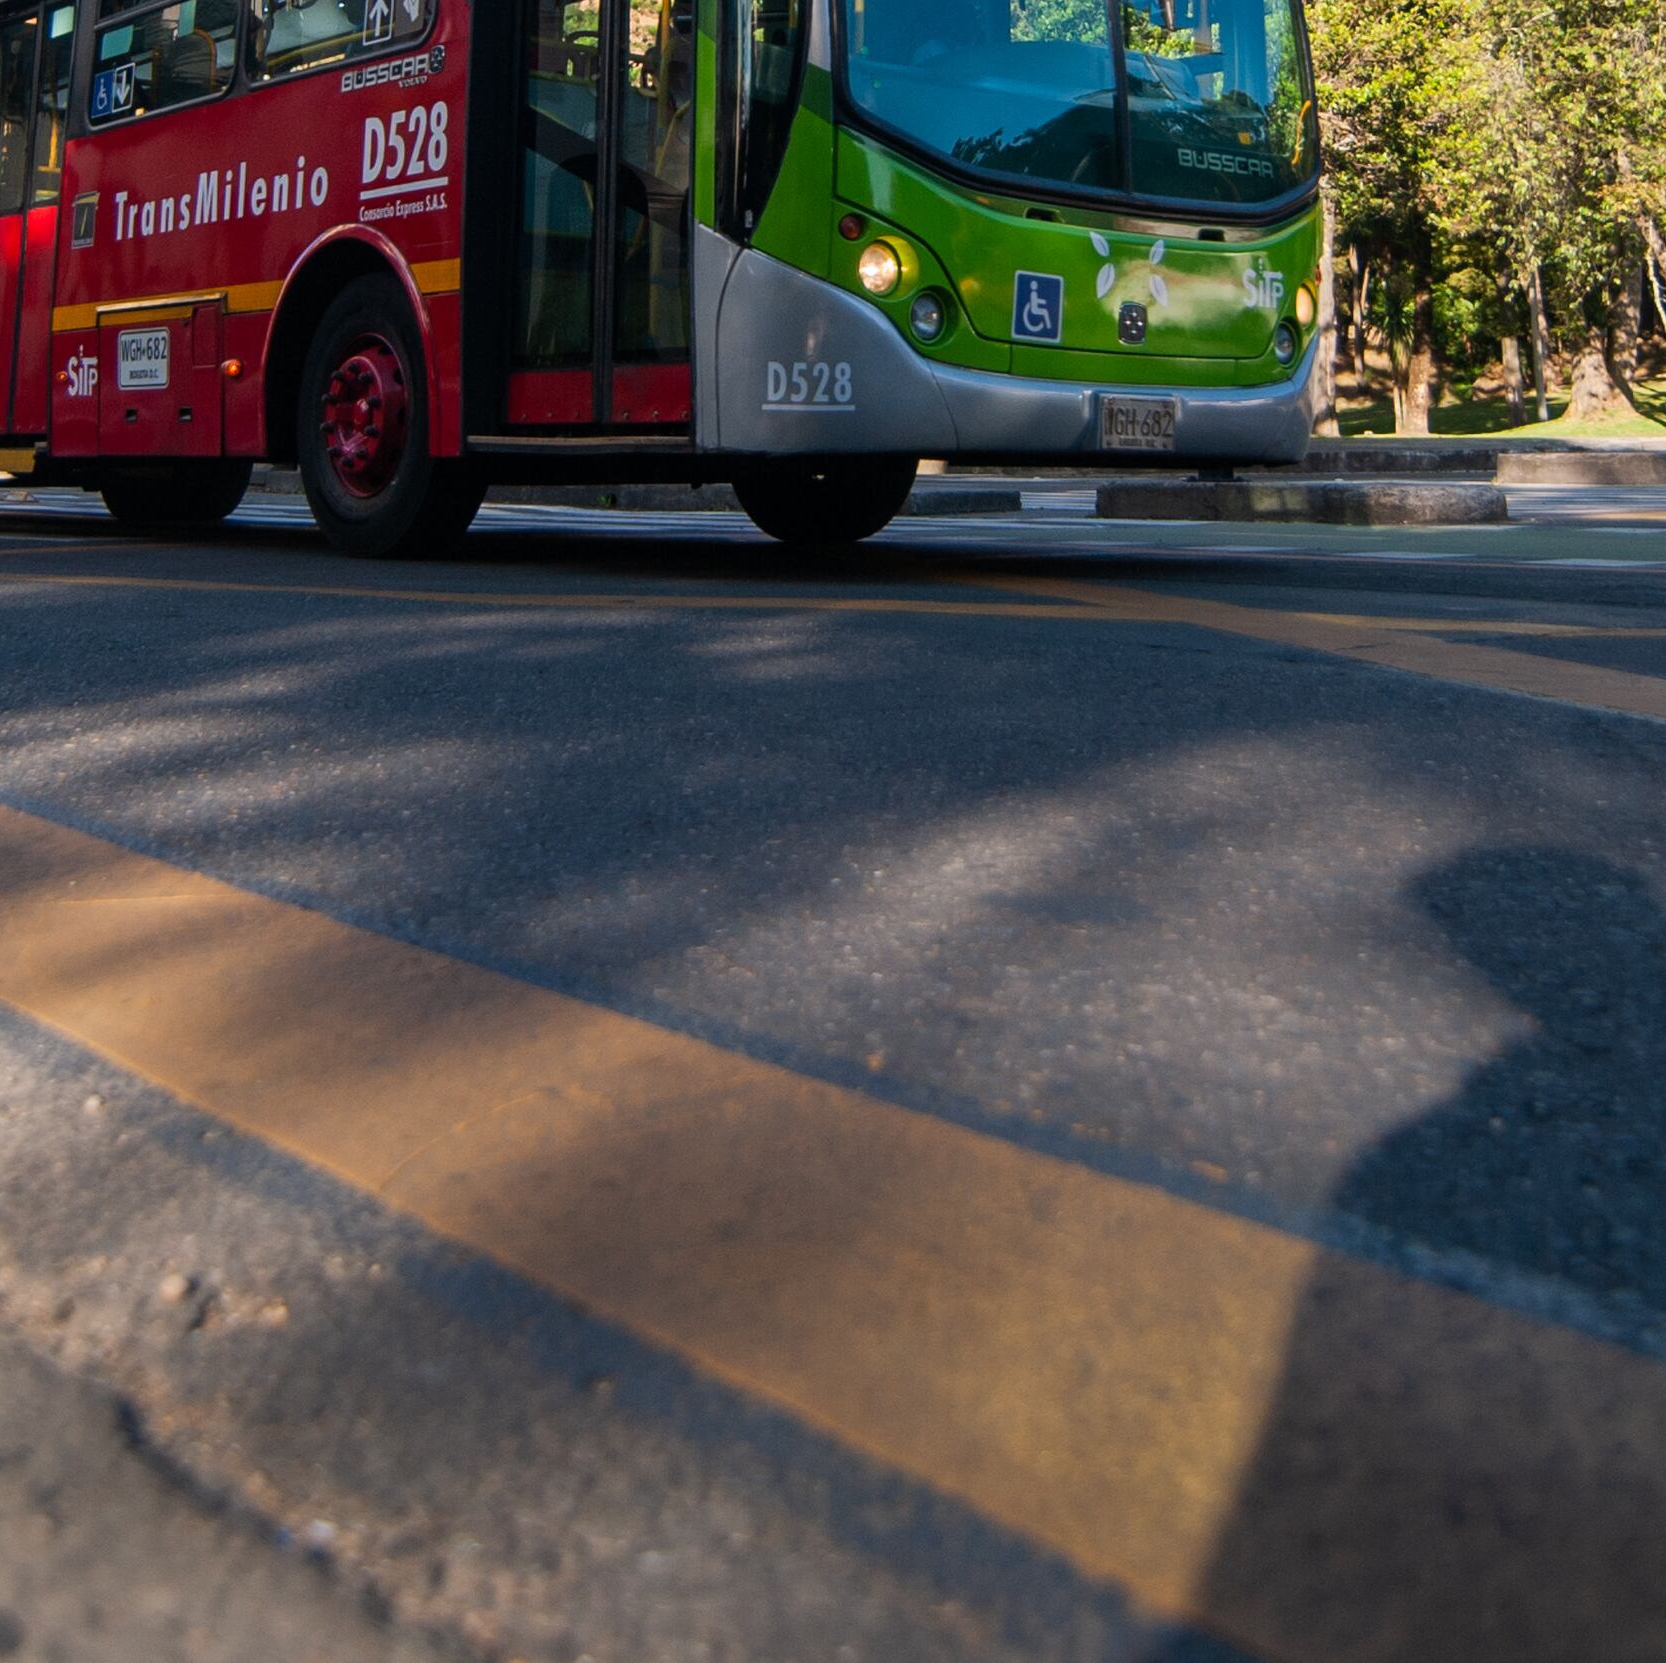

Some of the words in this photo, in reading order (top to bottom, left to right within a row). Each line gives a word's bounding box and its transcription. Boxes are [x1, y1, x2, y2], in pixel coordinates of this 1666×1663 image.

[340, 53, 430, 93] BUSSCAR
[361, 100, 449, 184] D528
[1176, 148, 1275, 179] BUSSCAR
[114, 155, 329, 241] TransMilenio
[766, 360, 853, 403] D528
